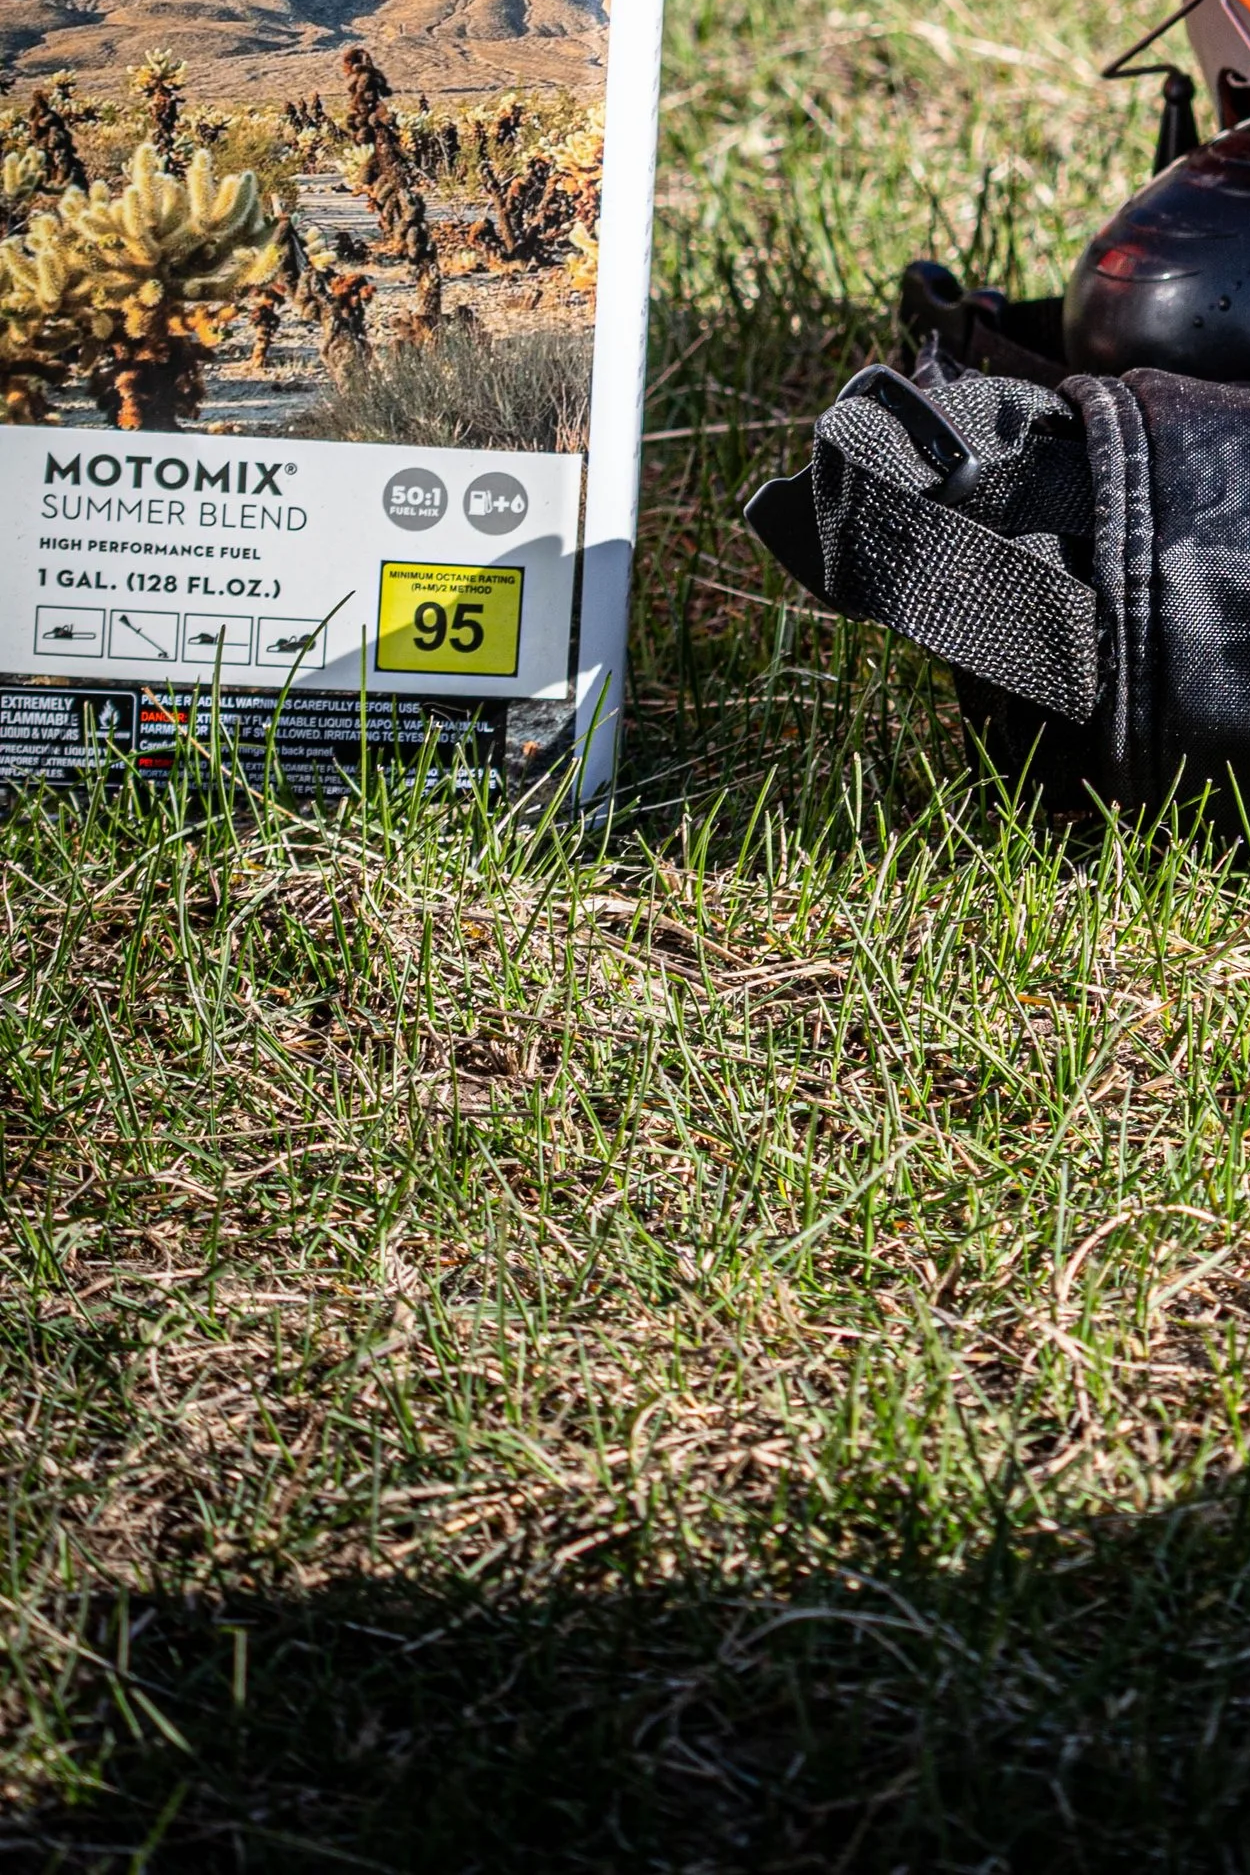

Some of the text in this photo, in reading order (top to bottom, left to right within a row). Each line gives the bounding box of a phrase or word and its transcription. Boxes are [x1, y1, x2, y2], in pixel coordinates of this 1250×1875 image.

[391, 485, 441, 506] 50:1
[41, 493, 307, 532] SUMMER BLEND
[390, 505, 440, 518] FUEL MIX
[39, 537, 262, 560] HIGH PERFORMANCE FUEL
[38, 568, 282, 600] 1 GAL. (128 FL.OZ.)
[389, 570, 516, 585] MINIMUM OCTANE RATING
[449, 584, 493, 595] METHOD
[413, 601, 485, 654] 95
[1, 695, 75, 711] EXTREMELY
[293, 699, 354, 712] CAREFULLY
[0, 710, 80, 727] FLAMMABLE
